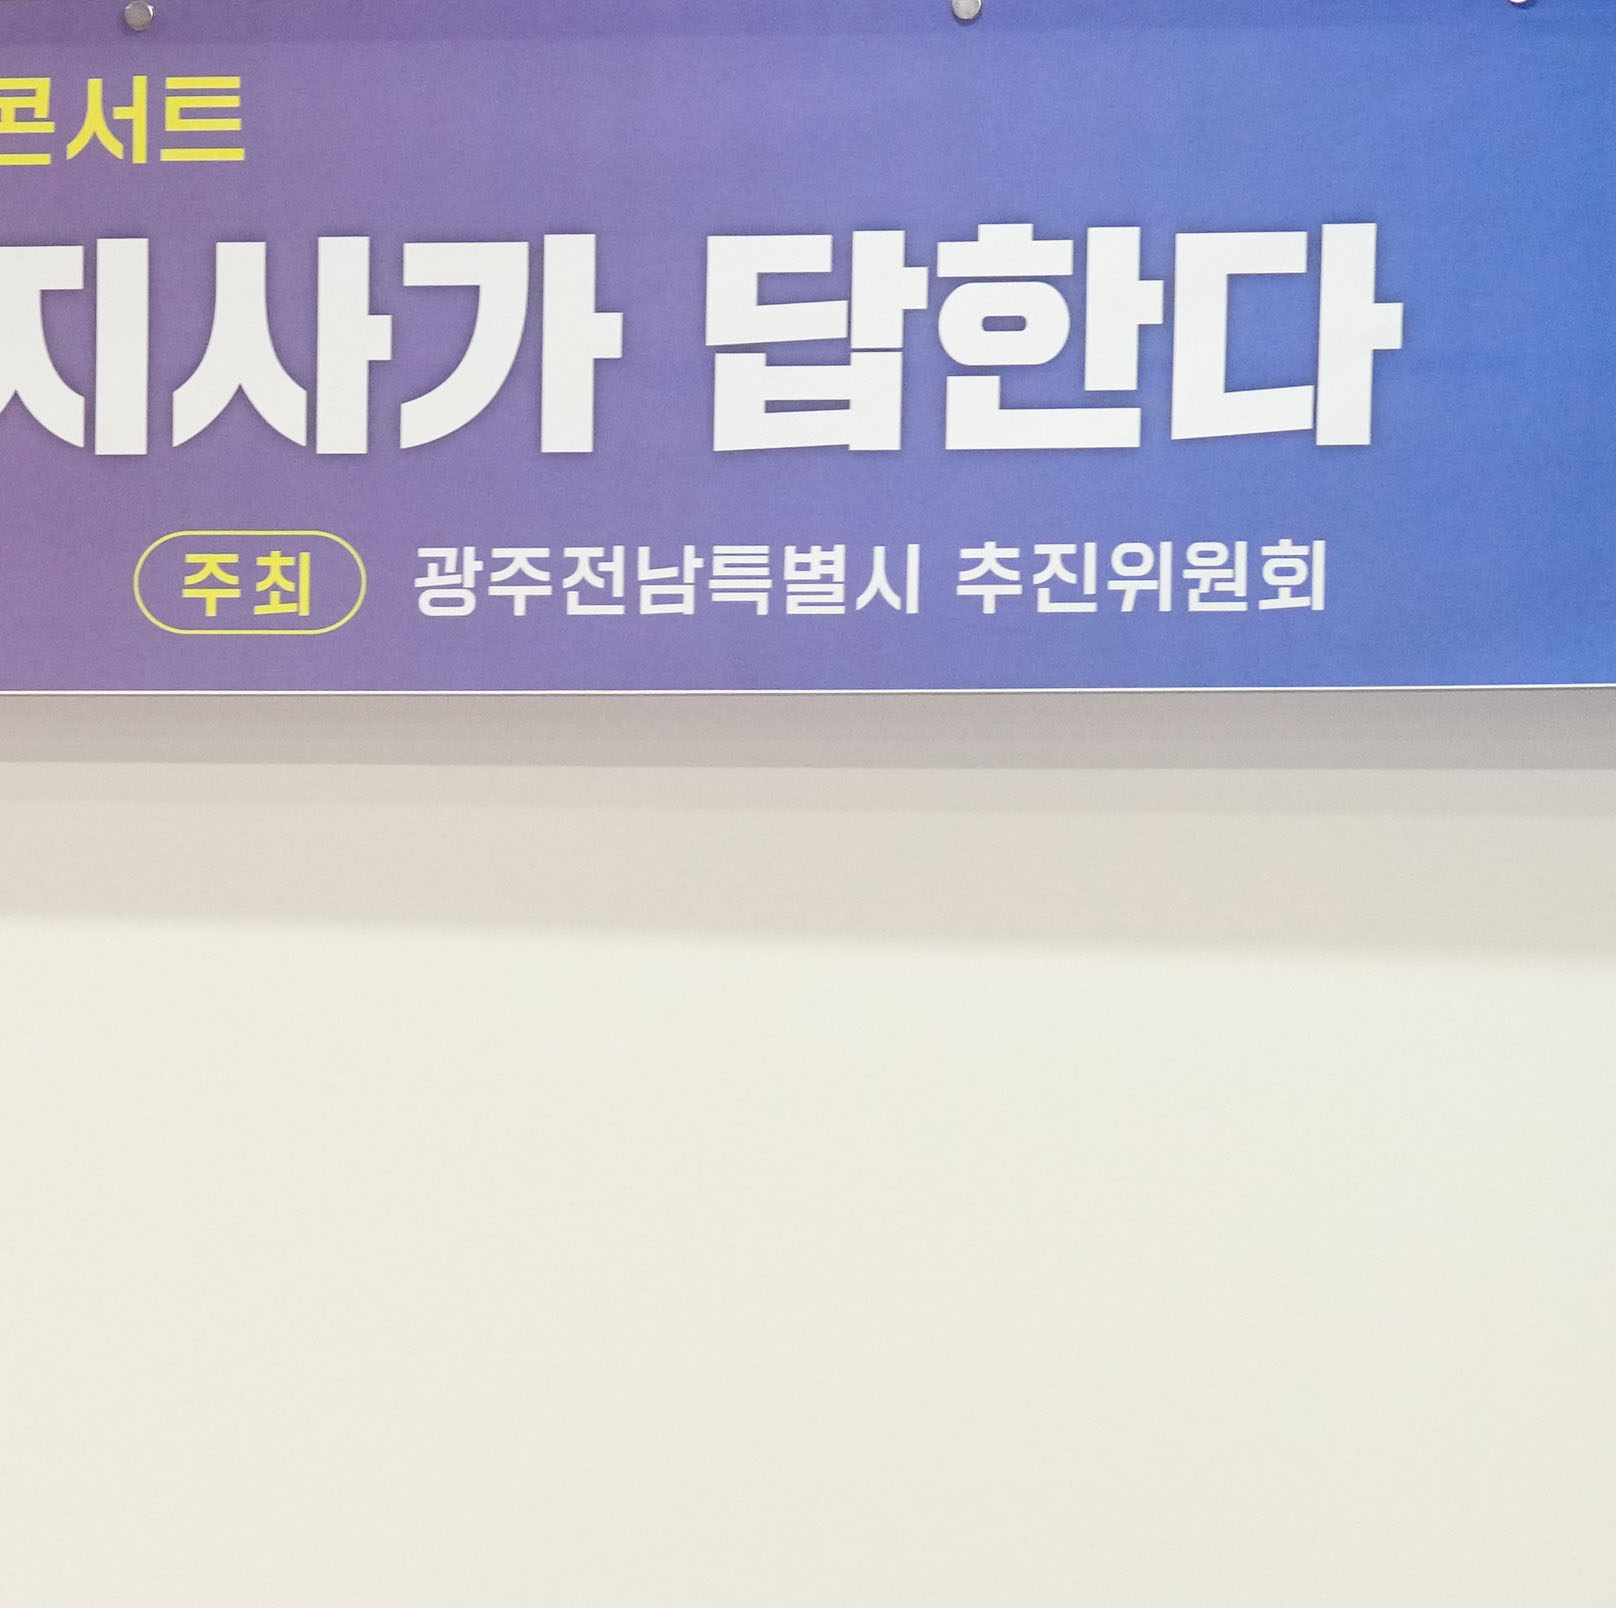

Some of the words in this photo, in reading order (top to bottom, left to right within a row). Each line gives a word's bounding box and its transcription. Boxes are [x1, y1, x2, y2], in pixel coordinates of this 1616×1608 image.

[704, 221, 1405, 453] 답한다
[182, 550, 311, 617] 주최
[413, 542, 921, 618] 광주전남특별시
[955, 537, 1327, 616] 추진위원회
